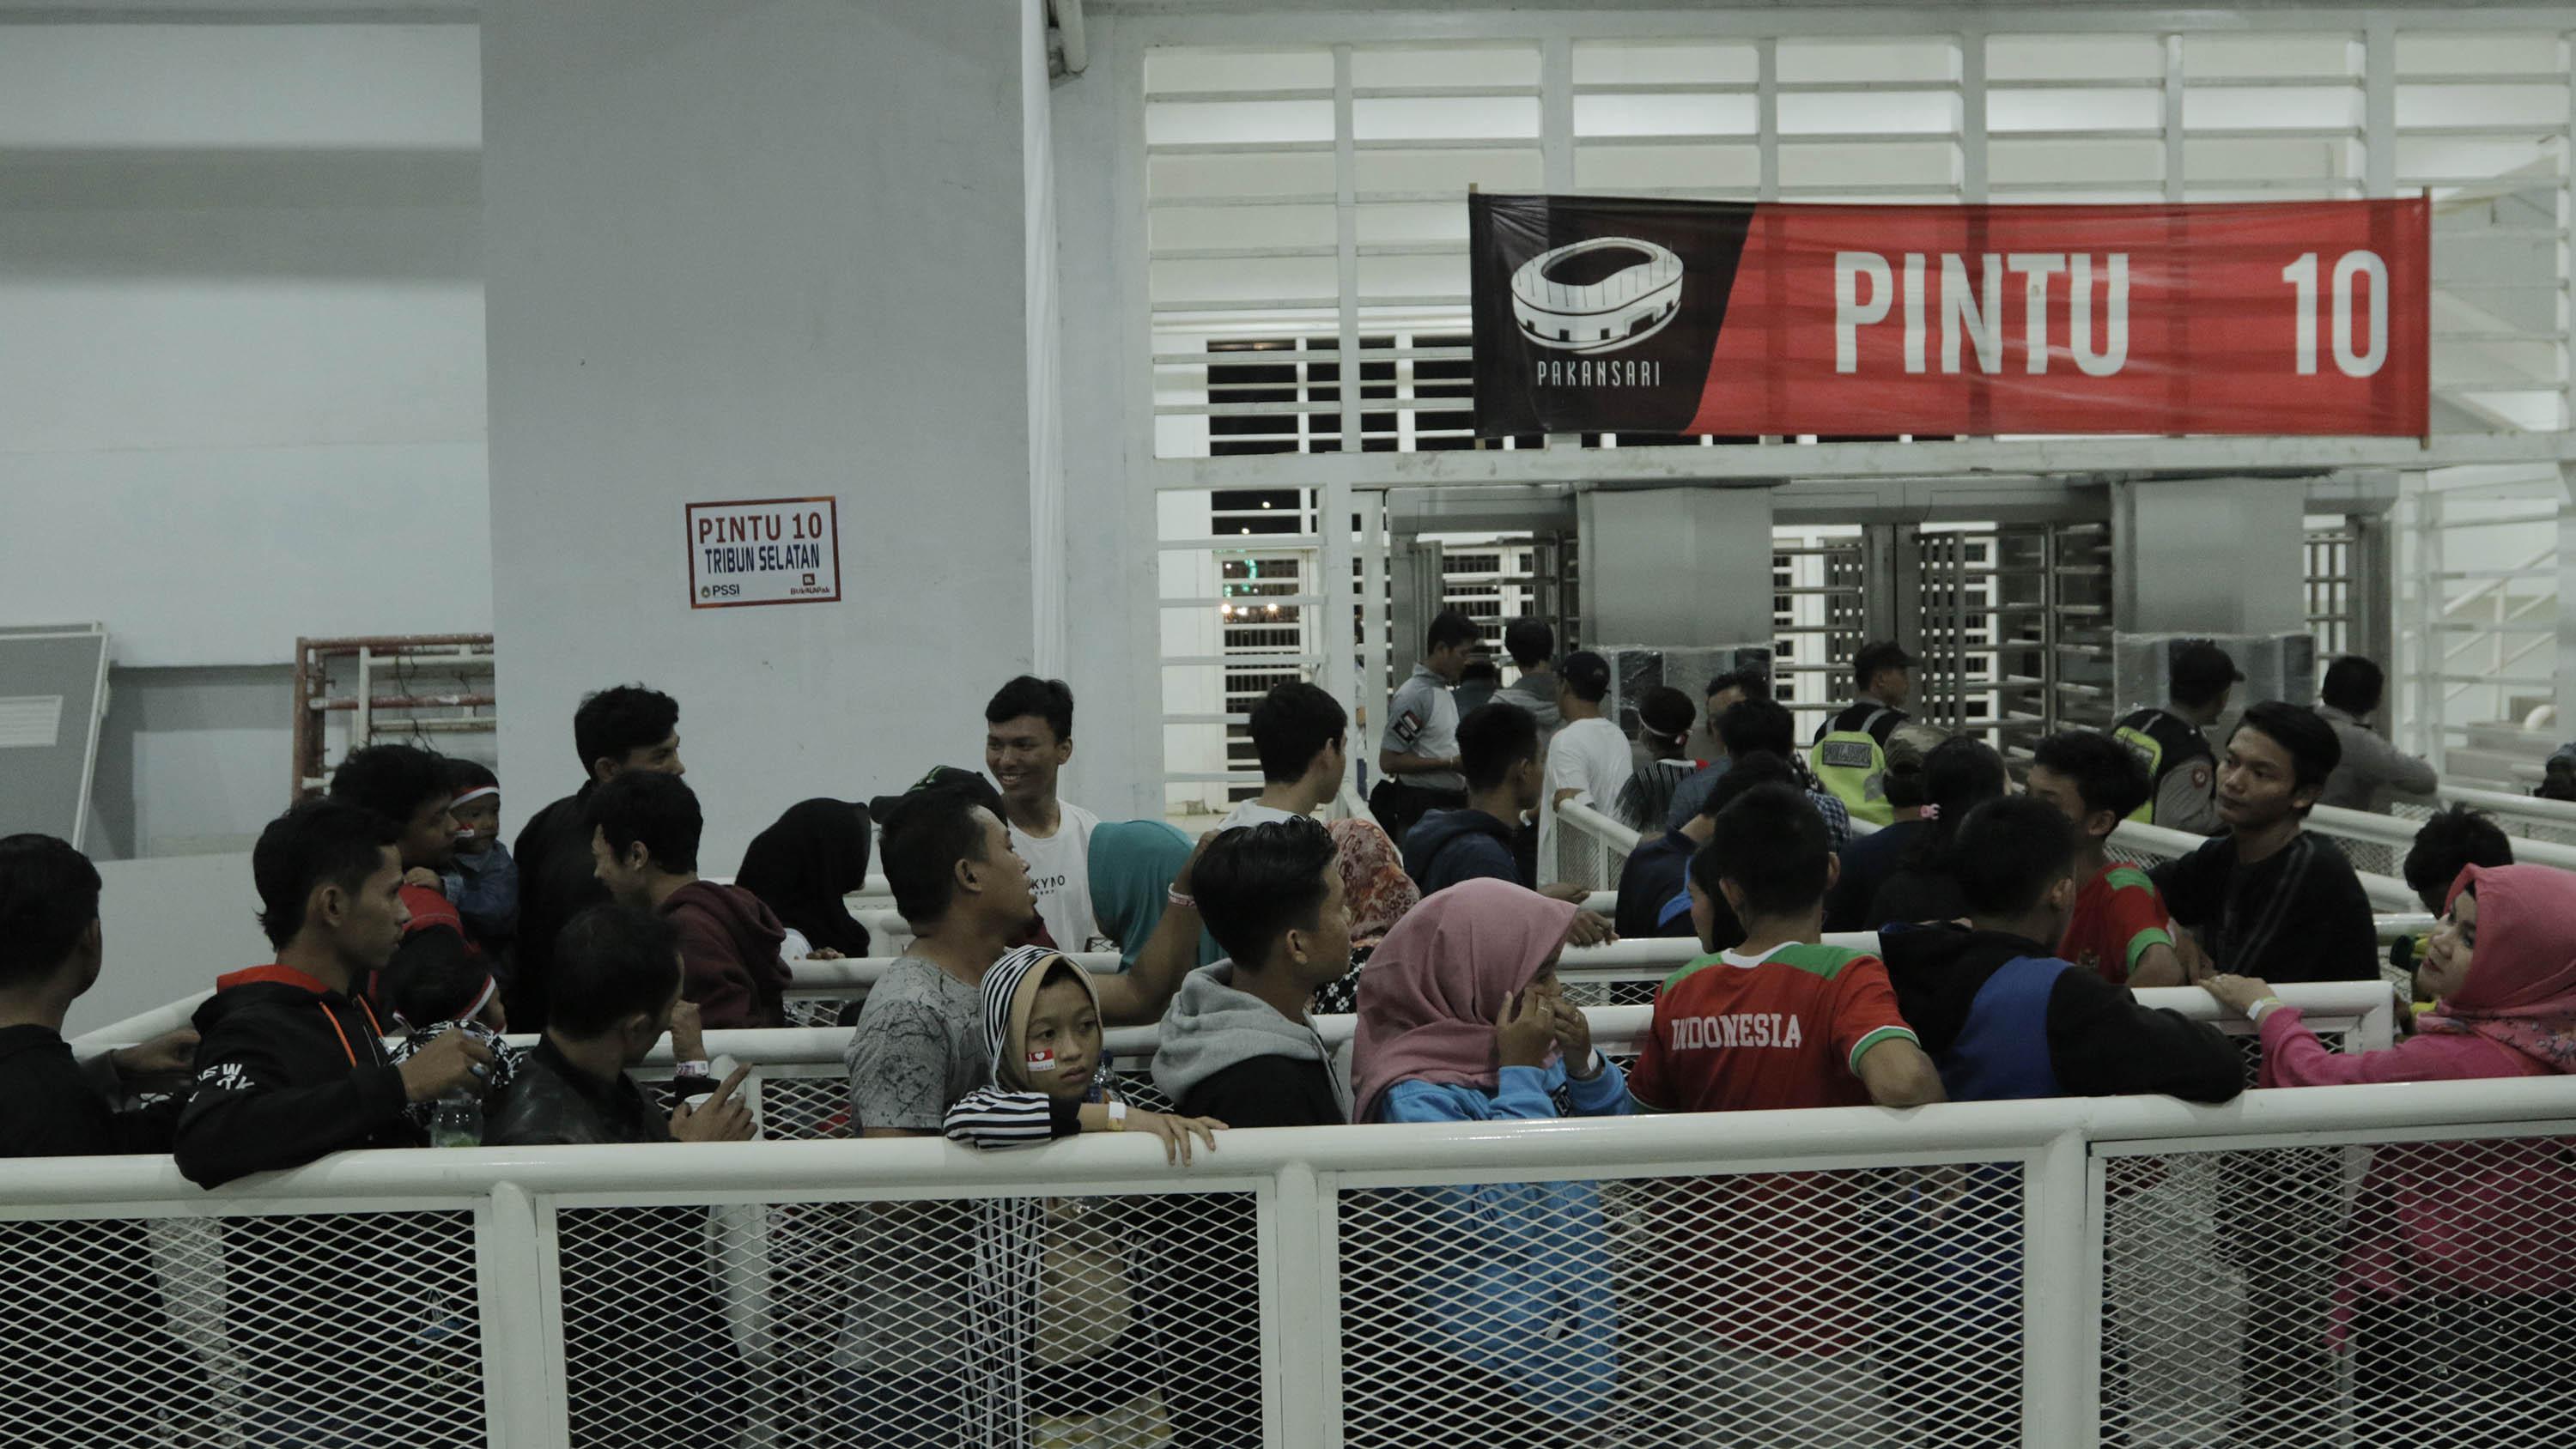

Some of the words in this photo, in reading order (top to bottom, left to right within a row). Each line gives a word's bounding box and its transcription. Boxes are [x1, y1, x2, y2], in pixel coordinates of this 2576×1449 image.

[1834, 252, 2129, 377] PINTU
[2281, 249, 2389, 378] 10
[1538, 360, 1661, 386] PAKANSARI
[699, 514, 781, 543] PINTU
[793, 512, 822, 539] 10
[705, 545, 755, 573] TRIBUN
[759, 543, 820, 571] SELATAN
[713, 584, 739, 597] PSSI
[1671, 1013, 1802, 1051] INDONESIA
